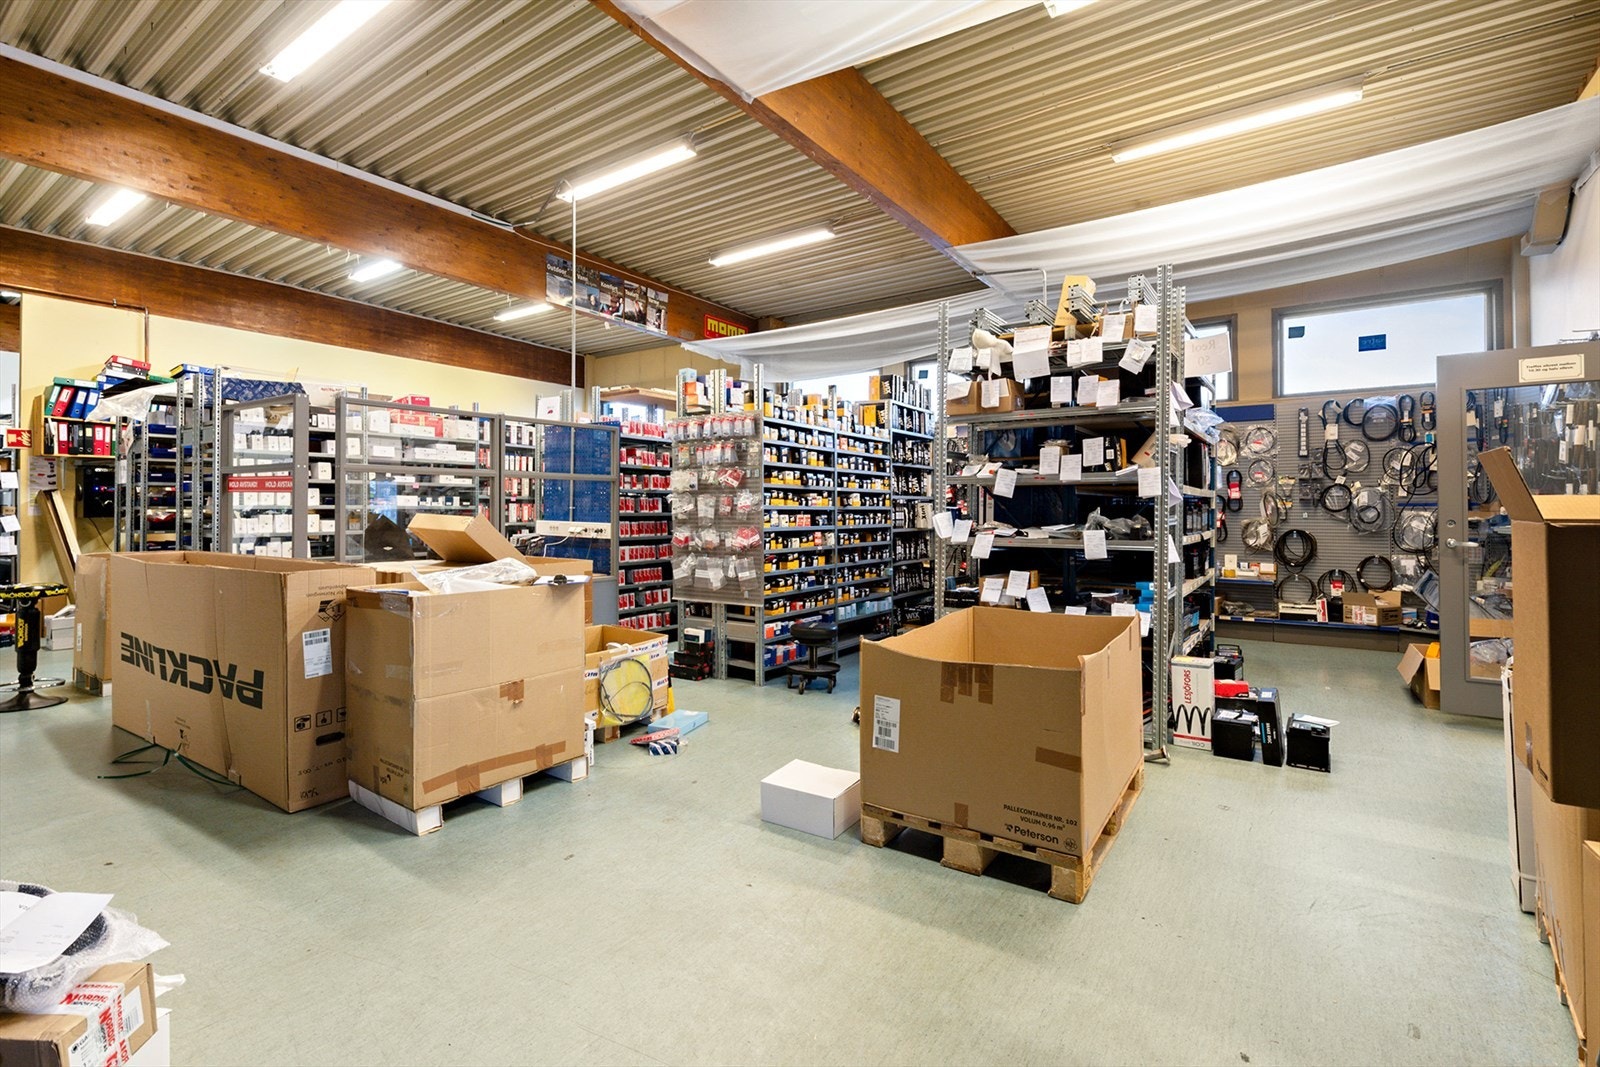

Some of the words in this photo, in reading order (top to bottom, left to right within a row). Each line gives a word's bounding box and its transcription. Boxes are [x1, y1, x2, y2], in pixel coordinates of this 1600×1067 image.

[120, 631, 264, 710] PACKLINE
[1003, 804, 1053, 820] PALLECONTAINER
[1053, 815, 1064, 823] NR.
[1020, 816, 1041, 826] VOLUM
[1014, 823, 1059, 845] Peterson
[99, 1006, 116, 1047] NORDIC
